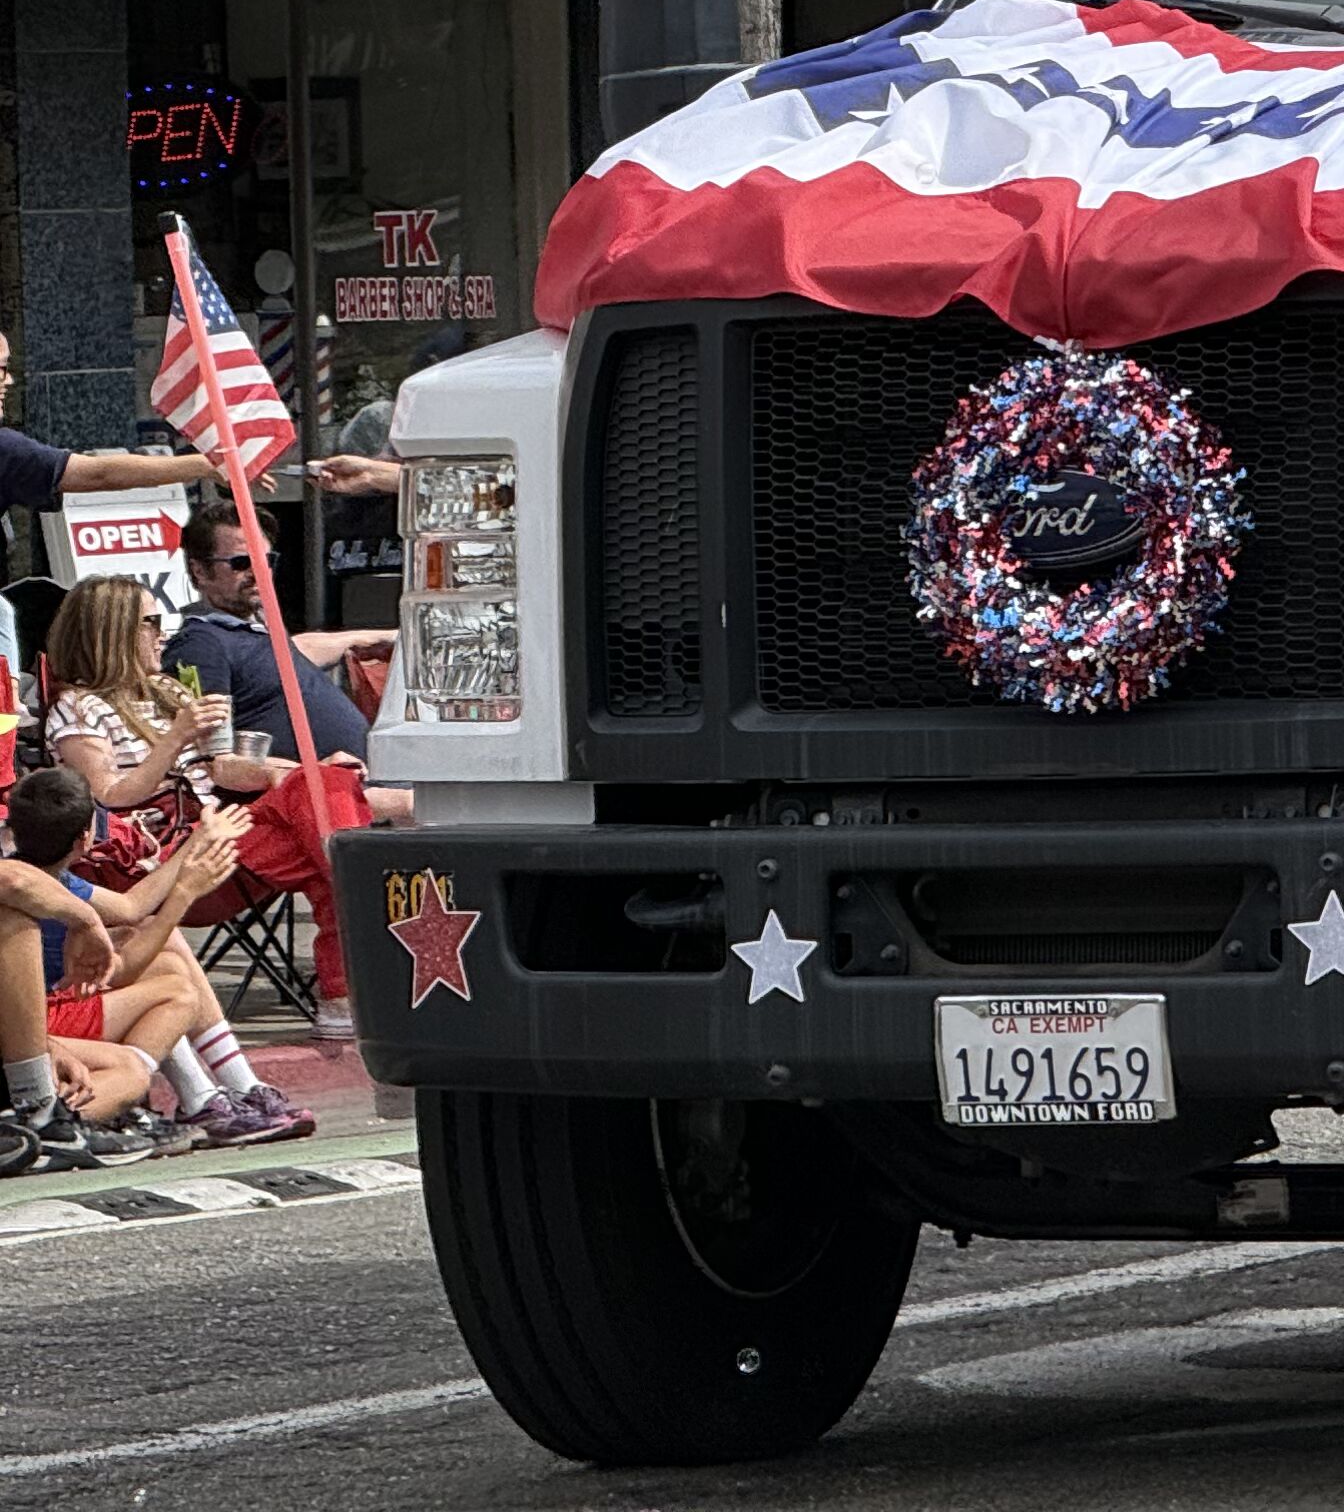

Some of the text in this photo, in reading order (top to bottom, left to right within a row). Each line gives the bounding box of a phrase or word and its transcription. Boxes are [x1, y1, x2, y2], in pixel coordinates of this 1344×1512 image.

[126, 98, 241, 163] PEN
[373, 210, 441, 268] TK
[335, 275, 497, 323] BARBER SHOP & SPA
[78, 522, 164, 551] OPEN
[990, 1000, 1108, 1015] SACRAMENTO
[991, 1016, 1108, 1034] CA EXEMPT
[955, 1046, 1150, 1103] 1491659
[960, 1101, 1154, 1124] DOWNTOWN FORD
